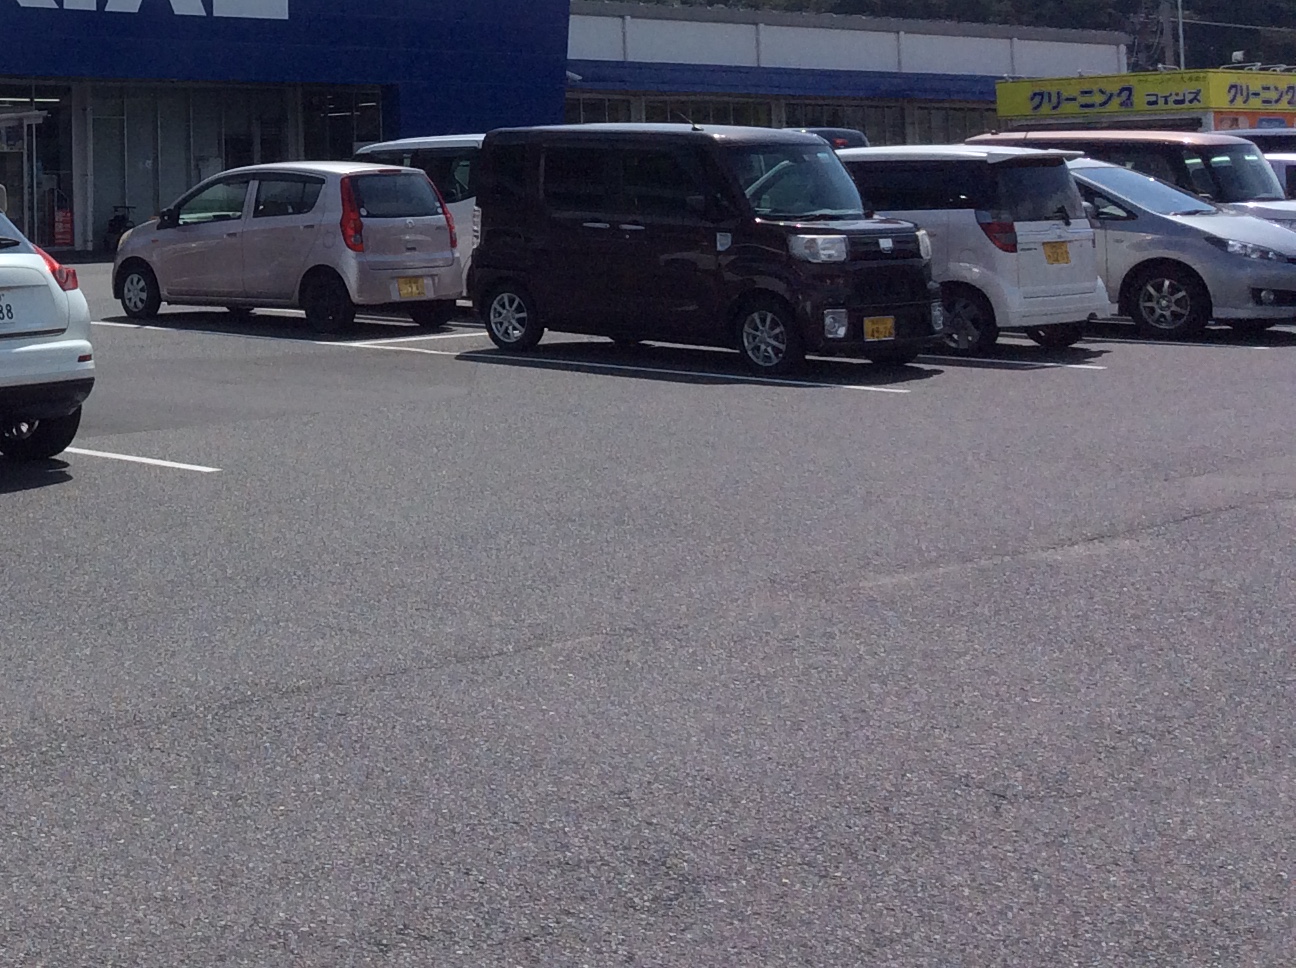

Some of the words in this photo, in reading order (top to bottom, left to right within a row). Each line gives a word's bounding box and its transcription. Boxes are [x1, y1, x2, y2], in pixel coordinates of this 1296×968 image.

[1029, 85, 1134, 111] クリーニング
